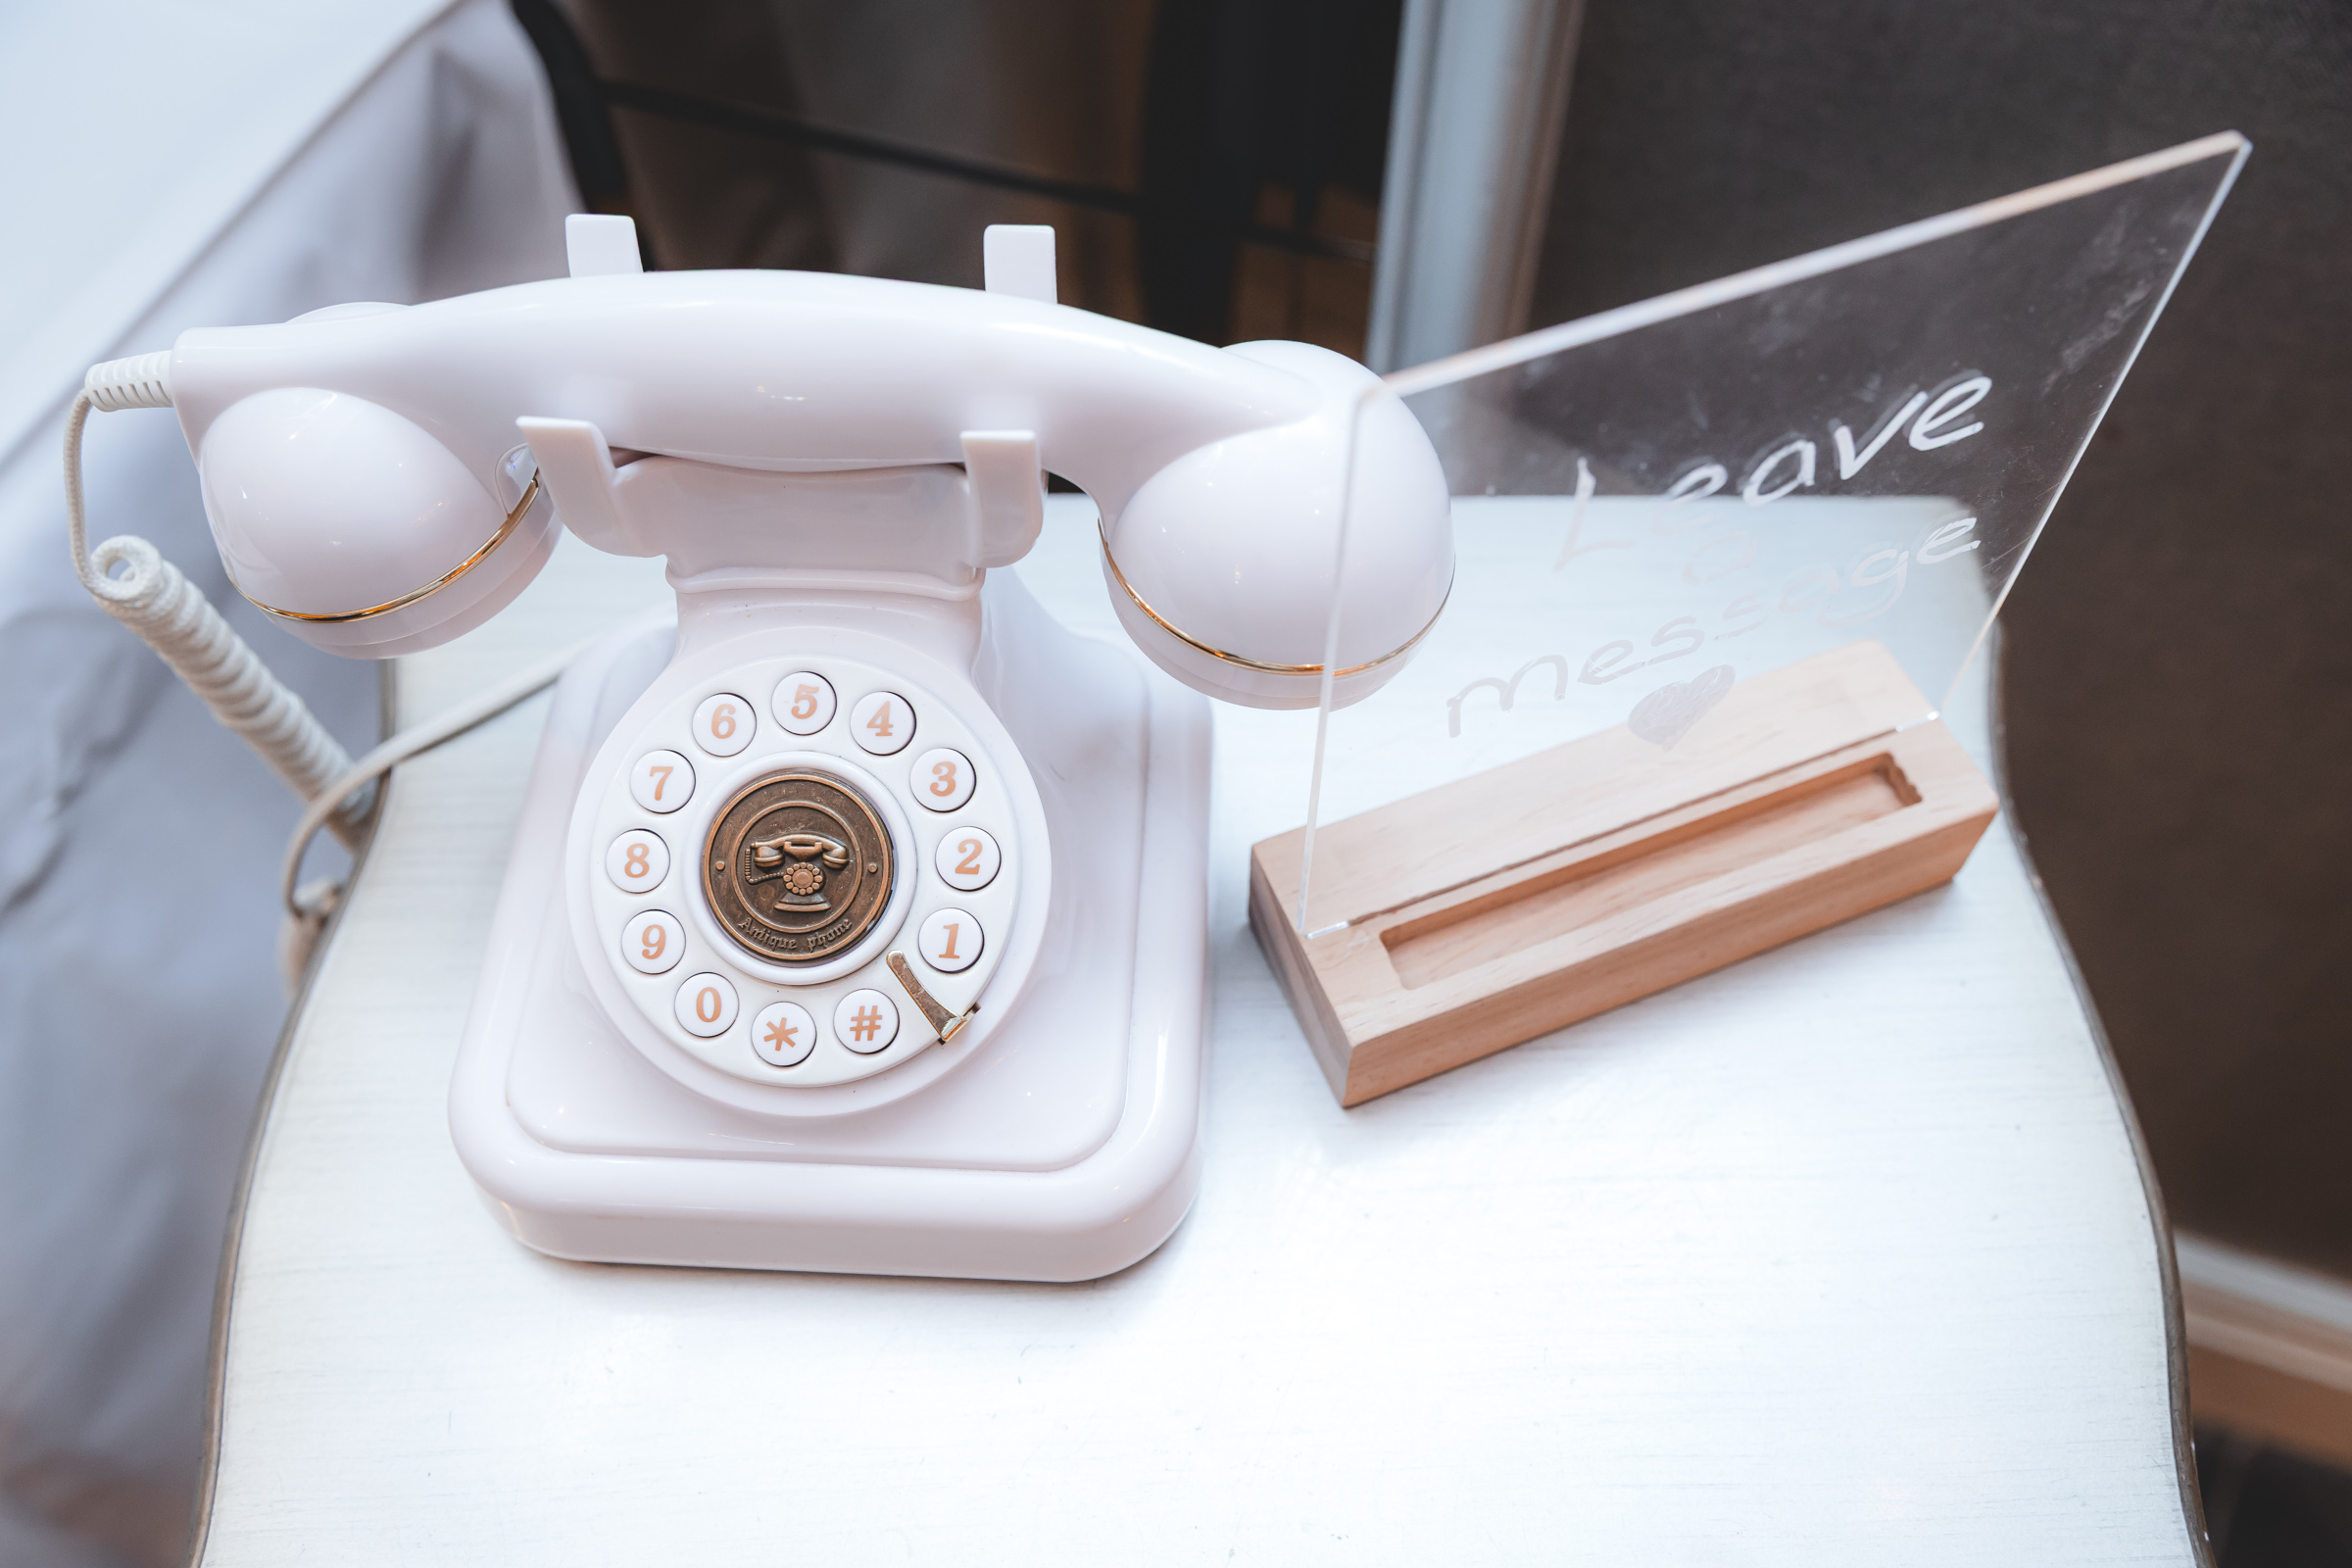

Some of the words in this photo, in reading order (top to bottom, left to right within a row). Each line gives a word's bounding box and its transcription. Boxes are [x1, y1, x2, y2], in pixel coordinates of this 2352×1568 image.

[1554, 374, 1992, 572] Leave
[1682, 530, 1756, 585] a
[1446, 516, 1981, 738] message
[791, 684, 819, 719] 5
[866, 702, 894, 737] 4
[711, 705, 736, 739] 6
[649, 766, 673, 802] 7
[929, 761, 956, 797] 3
[624, 843, 650, 879] 8
[955, 839, 983, 875] 2
[641, 924, 666, 960] 9
[737, 916, 798, 951] Antique
[807, 917, 853, 953] phone
[938, 923, 960, 959] 1
[696, 987, 722, 1023] 0
